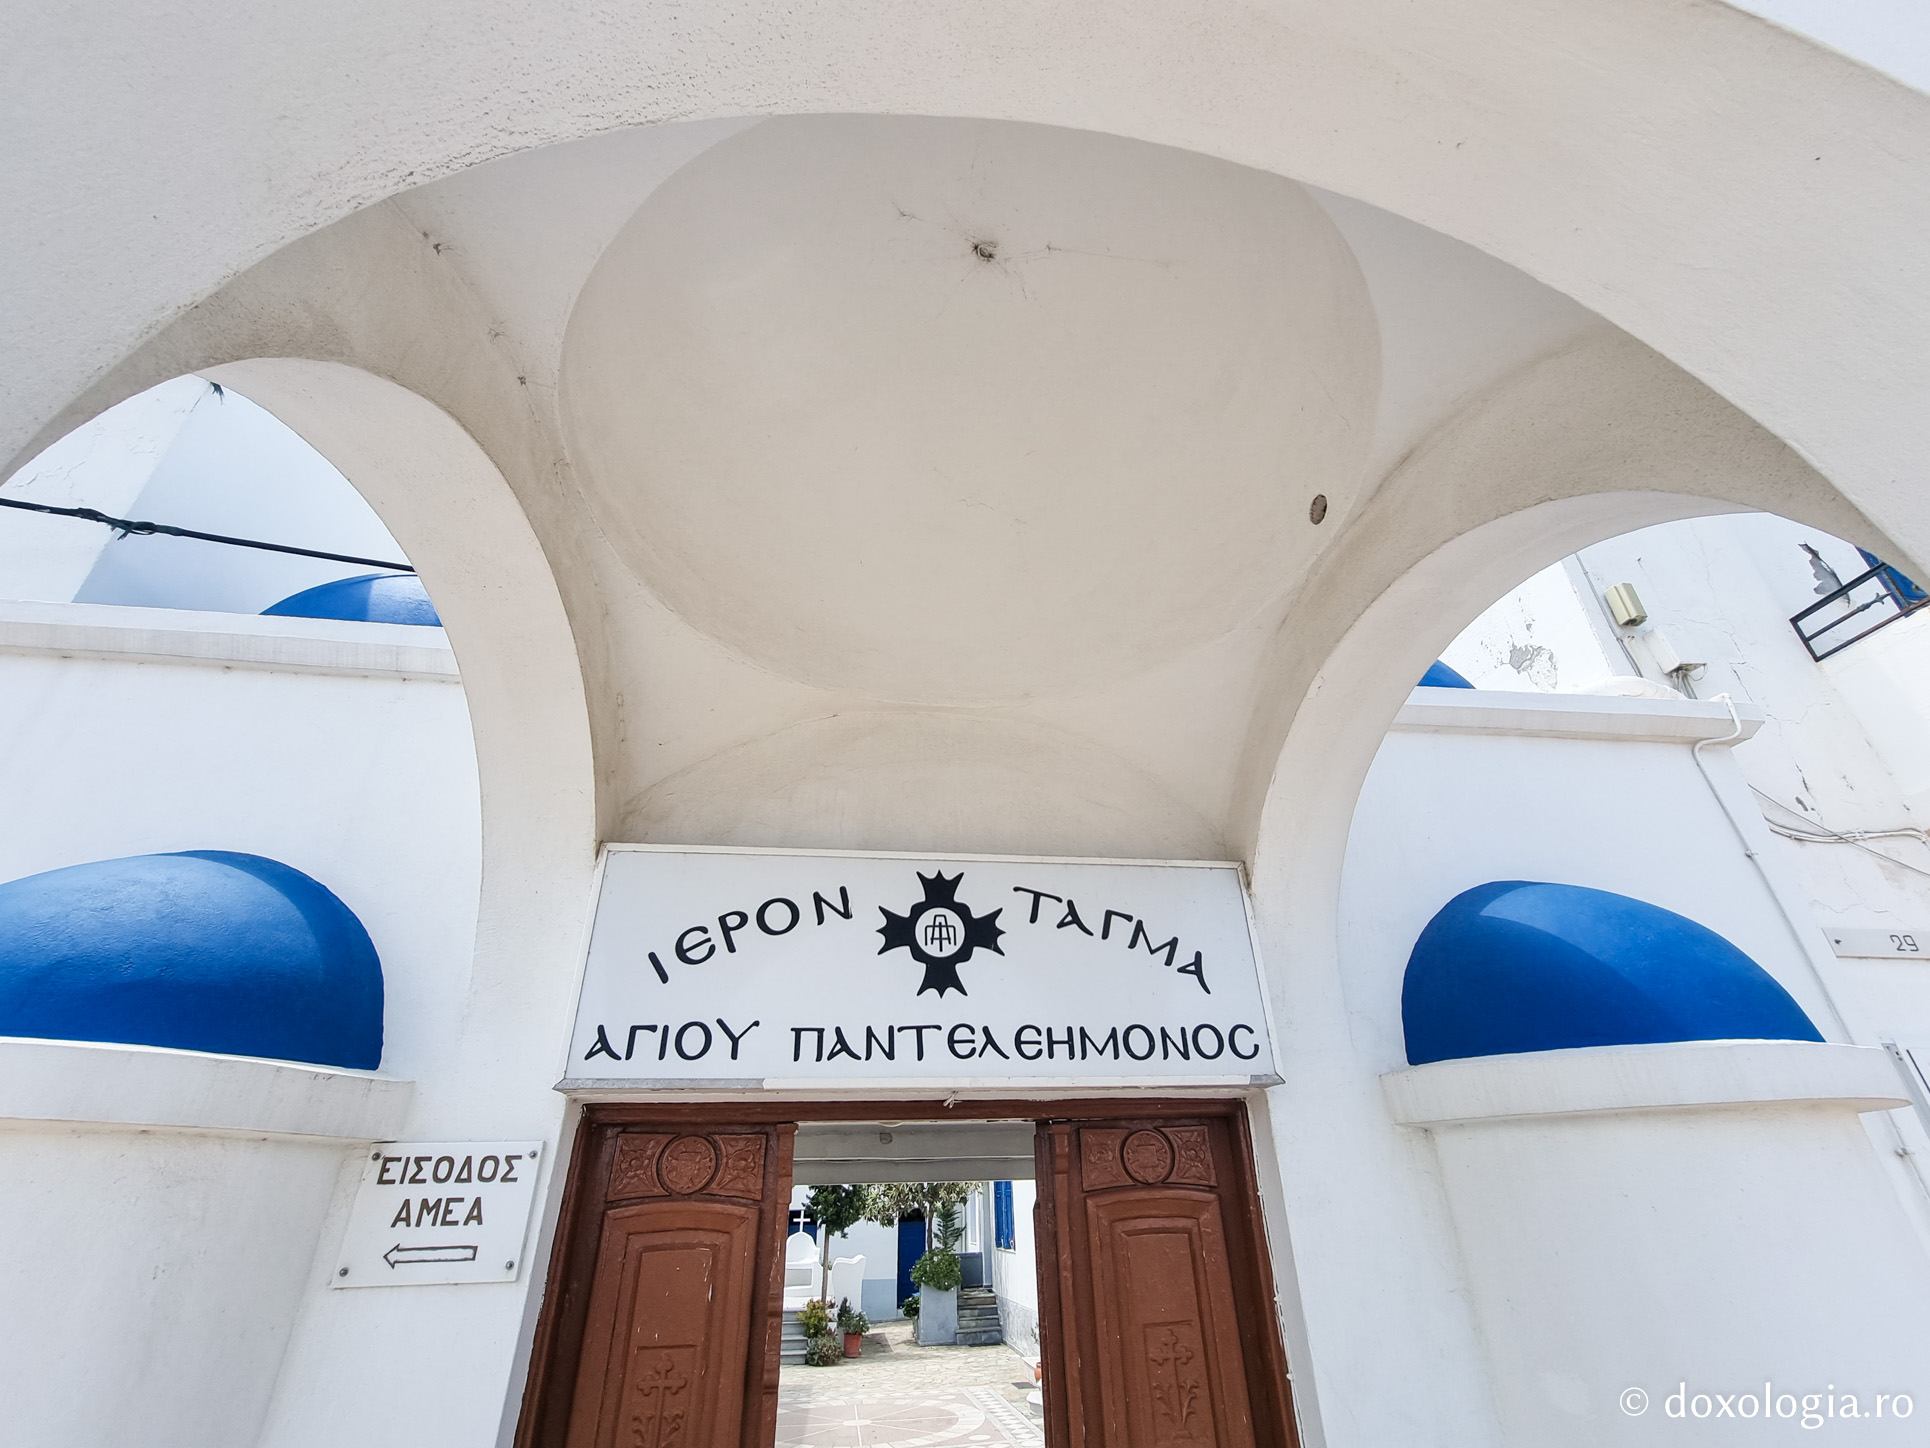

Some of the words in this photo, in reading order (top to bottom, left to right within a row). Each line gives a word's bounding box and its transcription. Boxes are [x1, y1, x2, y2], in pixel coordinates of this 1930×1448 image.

[647, 885, 853, 985] ΙΕΡΟΝ
[1012, 886, 1212, 995] ΤΑΓΜΑ
[1889, 934, 1920, 952] 29
[584, 1017, 760, 1062] ΑΓΙΟΥ
[376, 1154, 523, 1185] ΕΙΣΟΔΟΣ
[390, 1196, 484, 1228] ΑΜΕΑ
